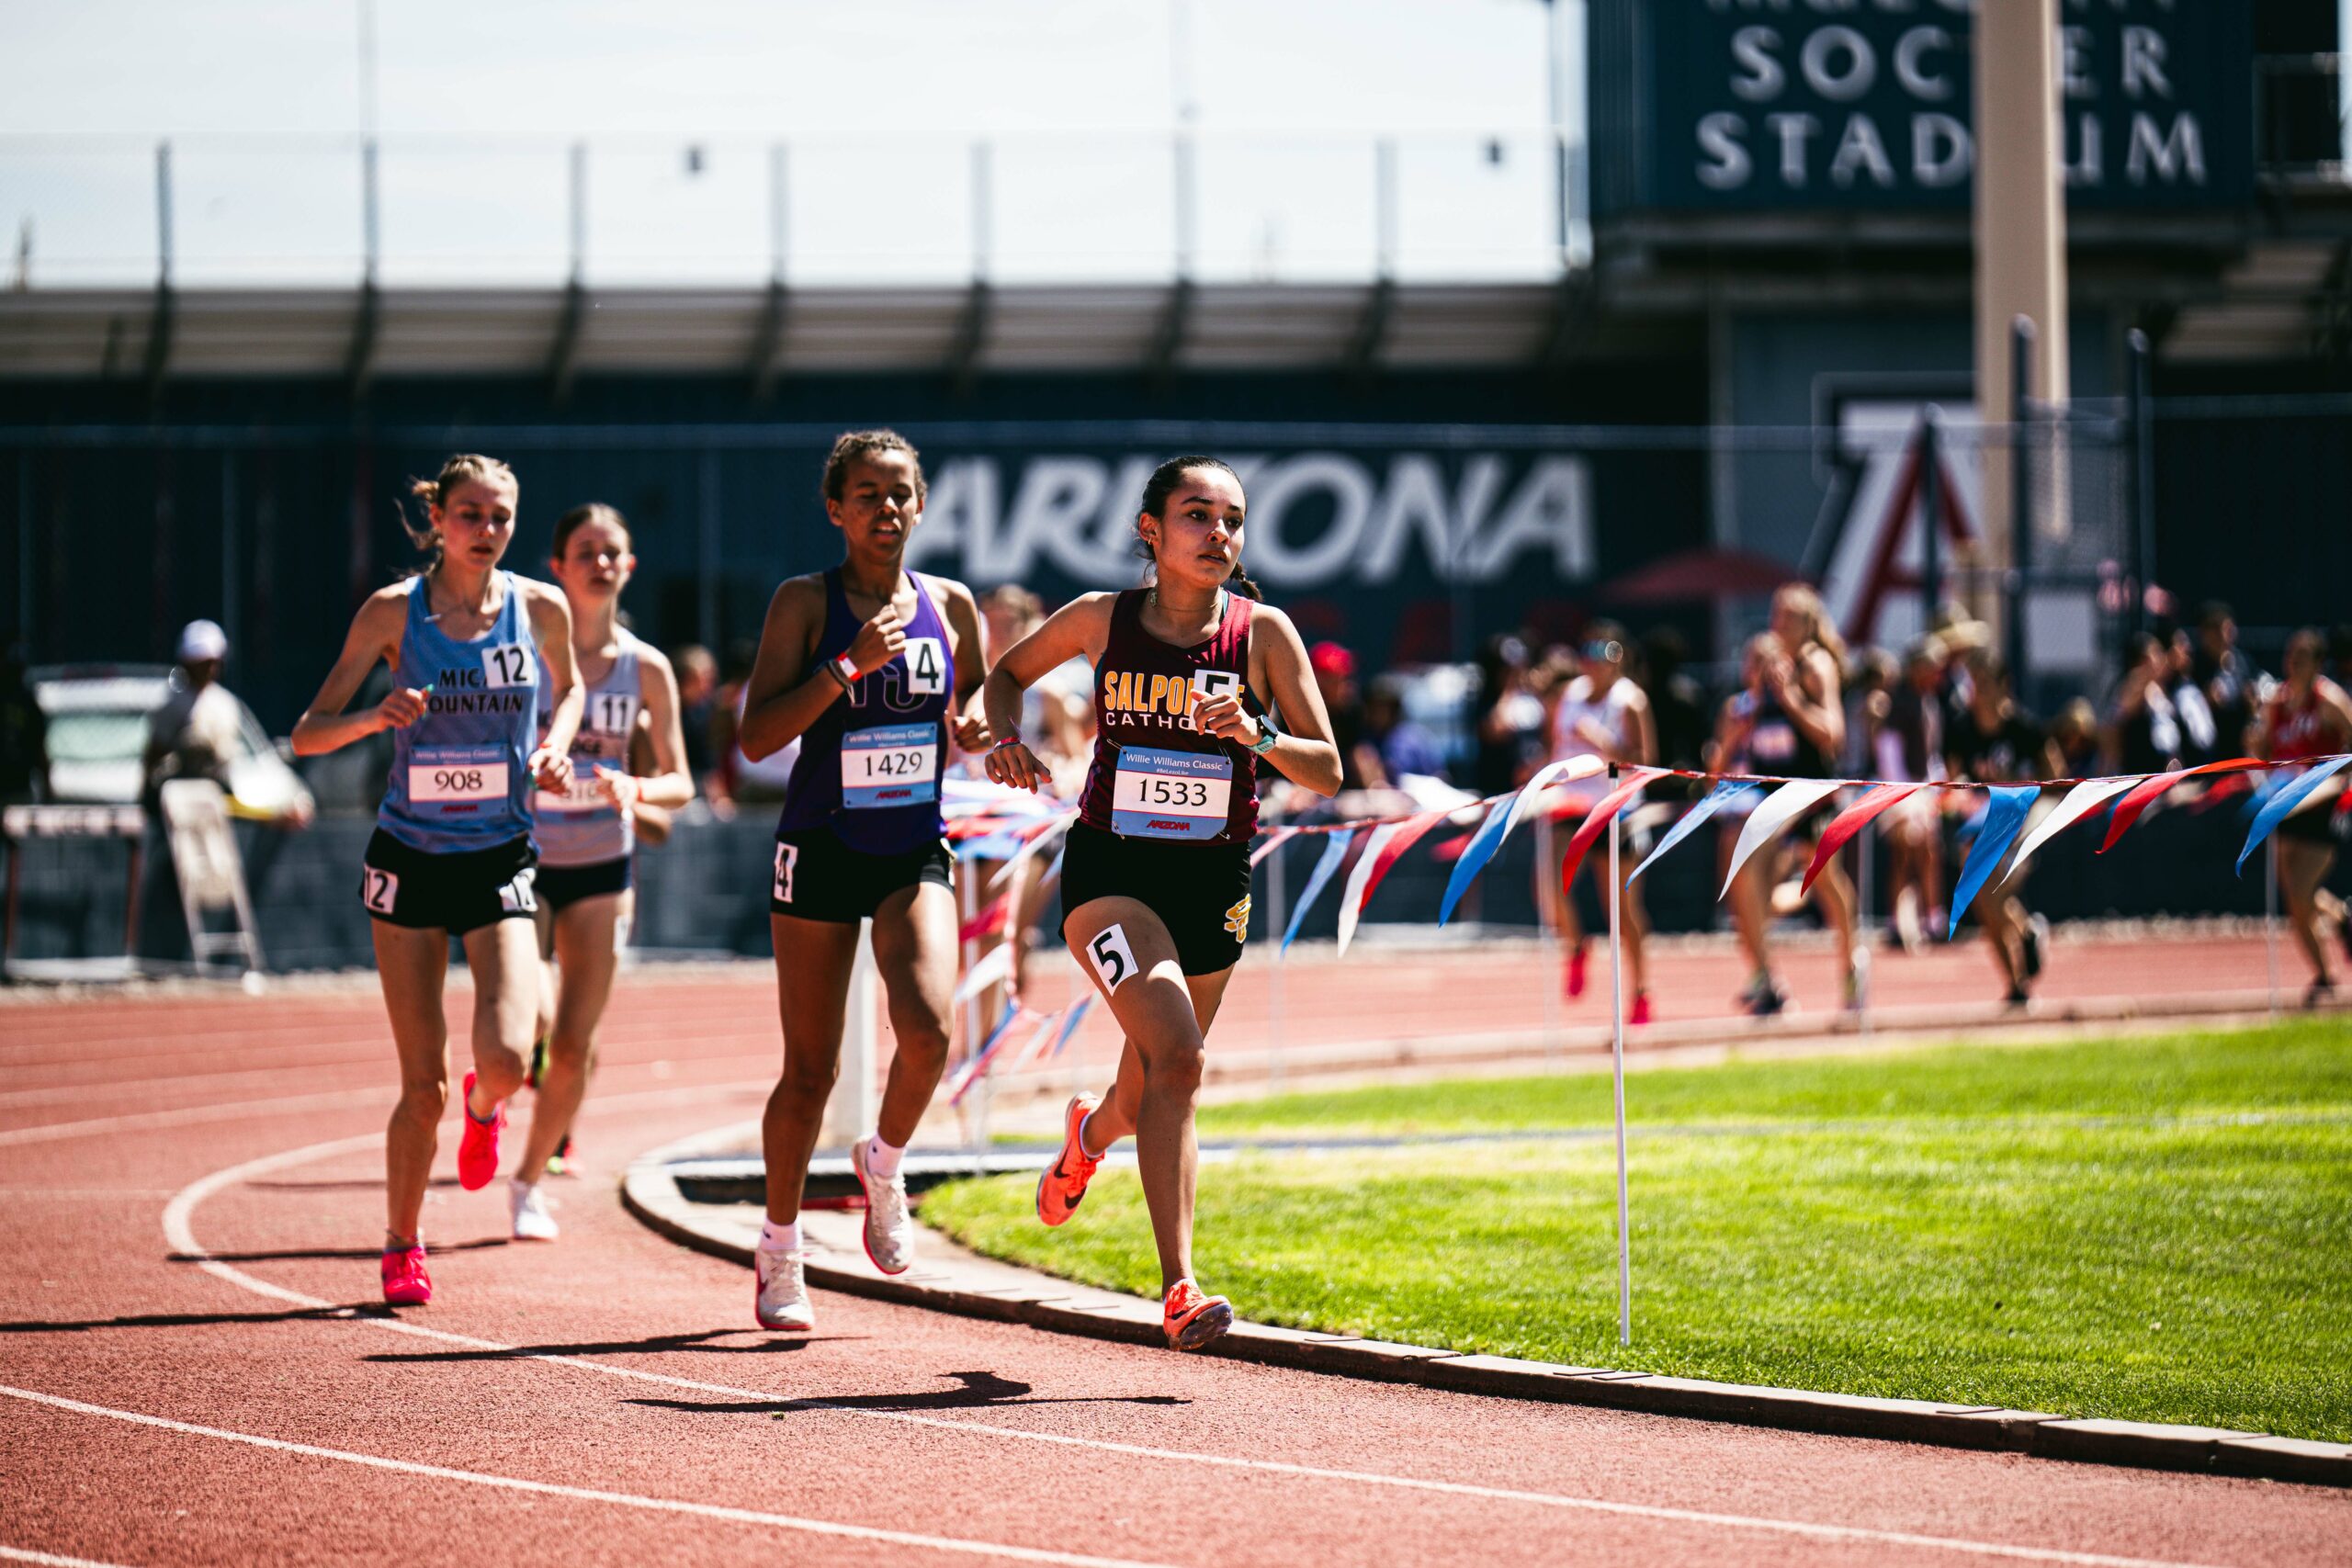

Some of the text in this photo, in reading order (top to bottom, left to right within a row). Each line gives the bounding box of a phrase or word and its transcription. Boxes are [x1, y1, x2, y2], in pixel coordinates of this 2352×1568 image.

[1730, 24, 2172, 101] SOCER
[1695, 110, 2209, 188] STADUM
[439, 668, 487, 688] MIC
[492, 647, 527, 683] 12
[916, 643, 939, 689] 4
[428, 694, 524, 714] OUNTAIN
[603, 695, 628, 731] 11
[1105, 712, 1192, 730] CATHO
[865, 751, 922, 776] 1429
[1126, 753, 1223, 771] Willie Williams Classic
[435, 770, 481, 792] 908
[1139, 778, 1207, 807] 1533
[1147, 819, 1190, 831] ARIZONA
[1093, 931, 1125, 987] 5
